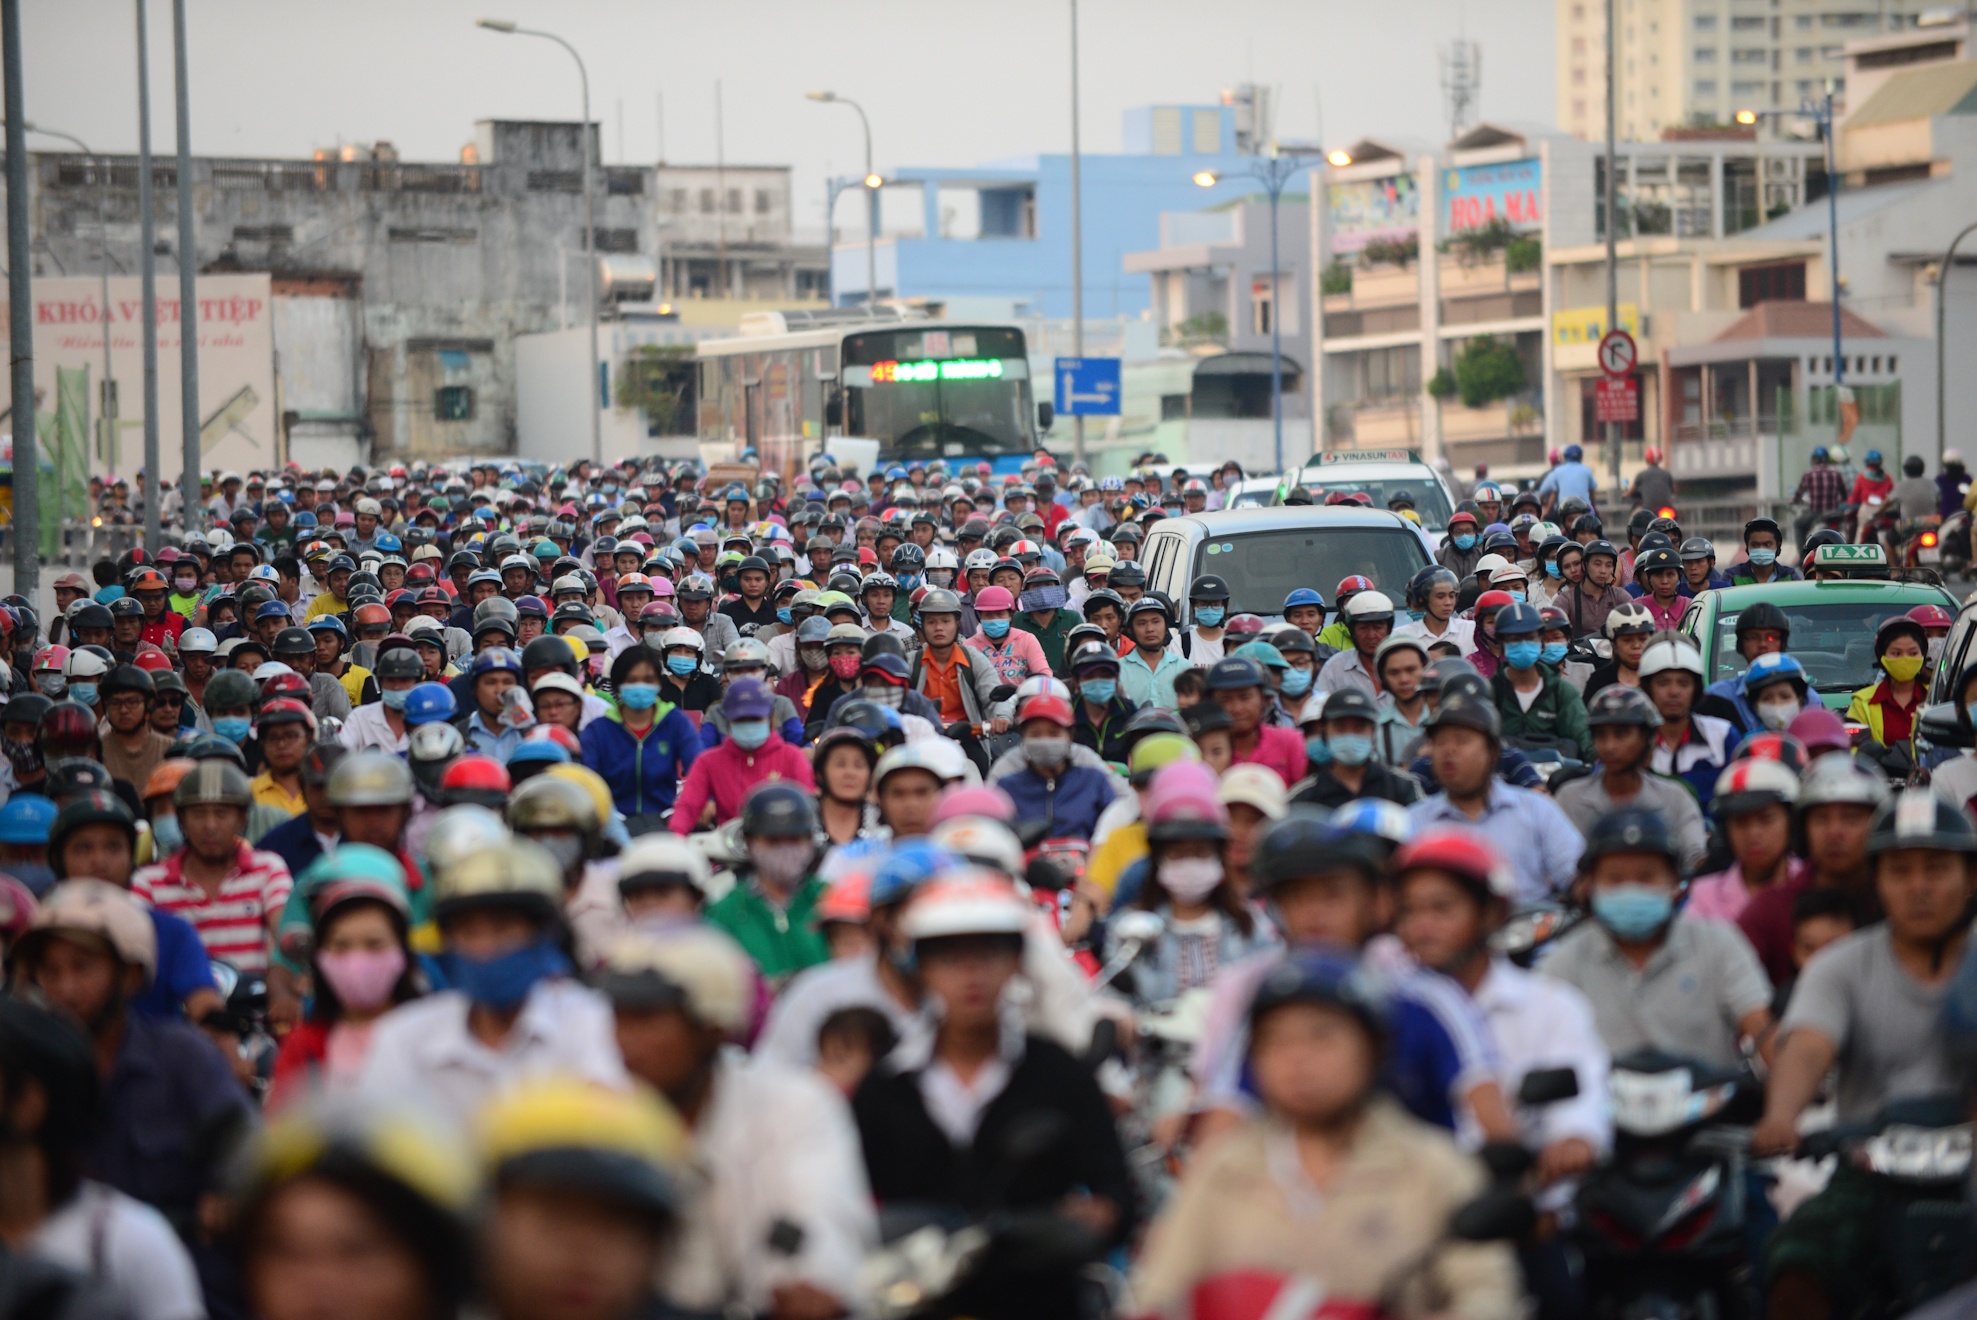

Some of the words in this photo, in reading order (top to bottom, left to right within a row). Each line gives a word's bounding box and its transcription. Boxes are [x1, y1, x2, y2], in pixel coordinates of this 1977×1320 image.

[1449, 193, 1496, 231] HOA
[1504, 189, 1541, 223] MA
[119, 296, 181, 327] VỆT
[199, 295, 262, 326] TIỆP
[869, 360, 899, 381] 45
